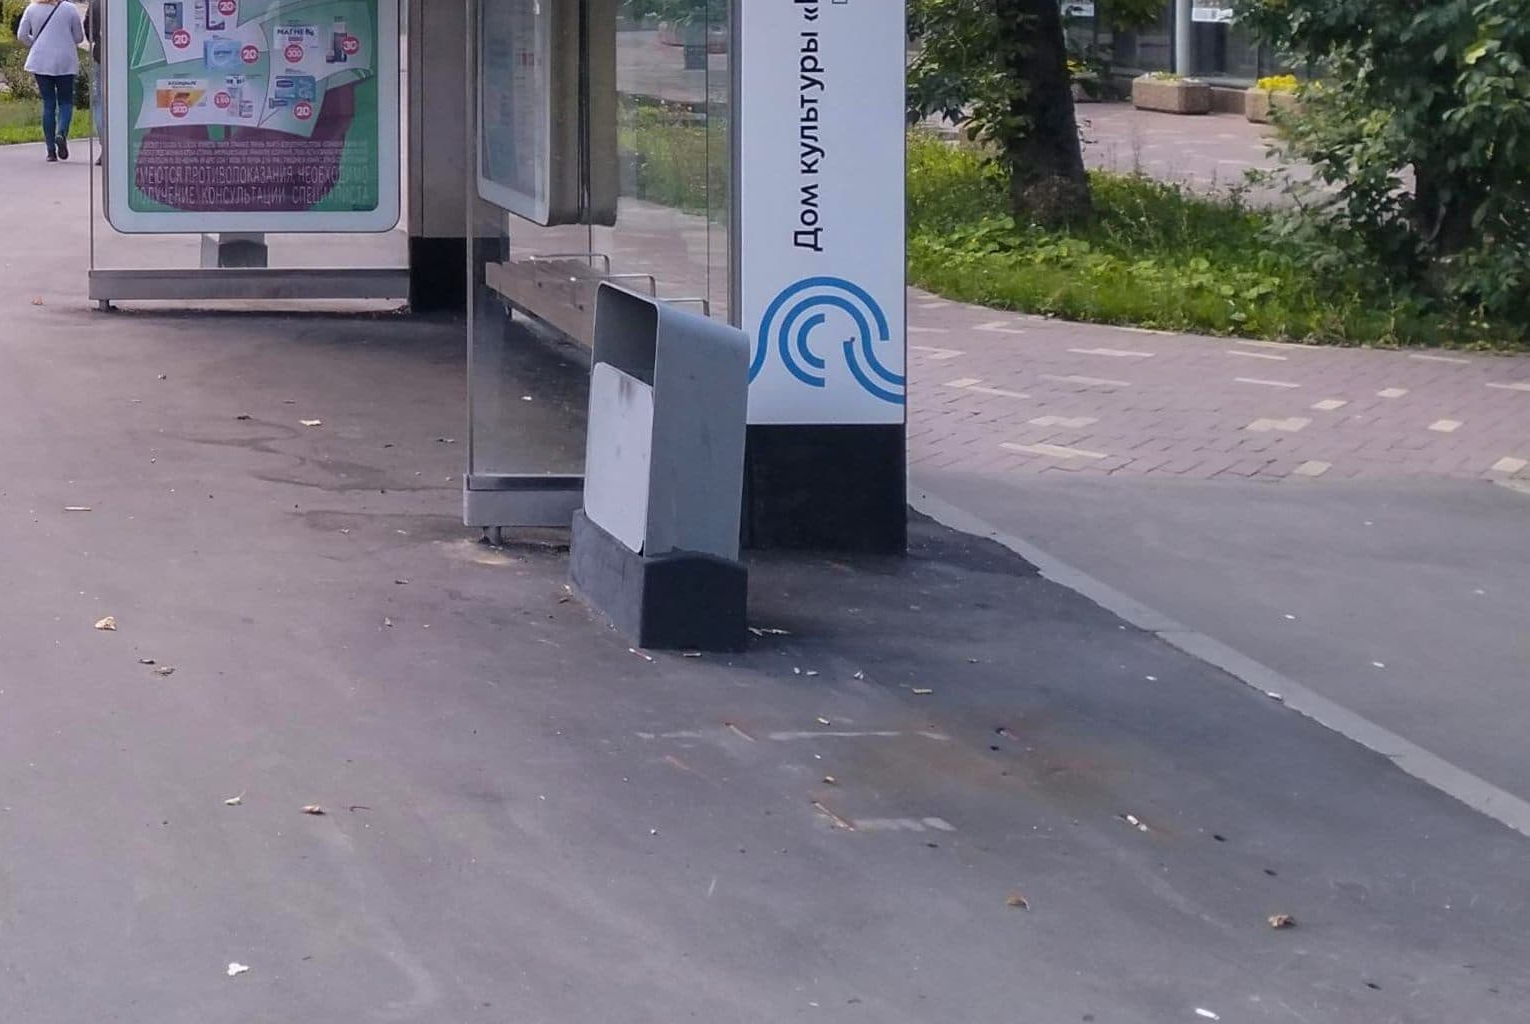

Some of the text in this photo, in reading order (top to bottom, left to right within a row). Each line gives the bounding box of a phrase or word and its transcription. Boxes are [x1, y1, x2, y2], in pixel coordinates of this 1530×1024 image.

[219, 1, 235, 12] 20
[173, 34, 188, 45] 20
[243, 49, 257, 60] 20
[799, 31, 826, 175] культуры
[296, 105, 310, 117] 20
[793, 183, 824, 253] Дом
